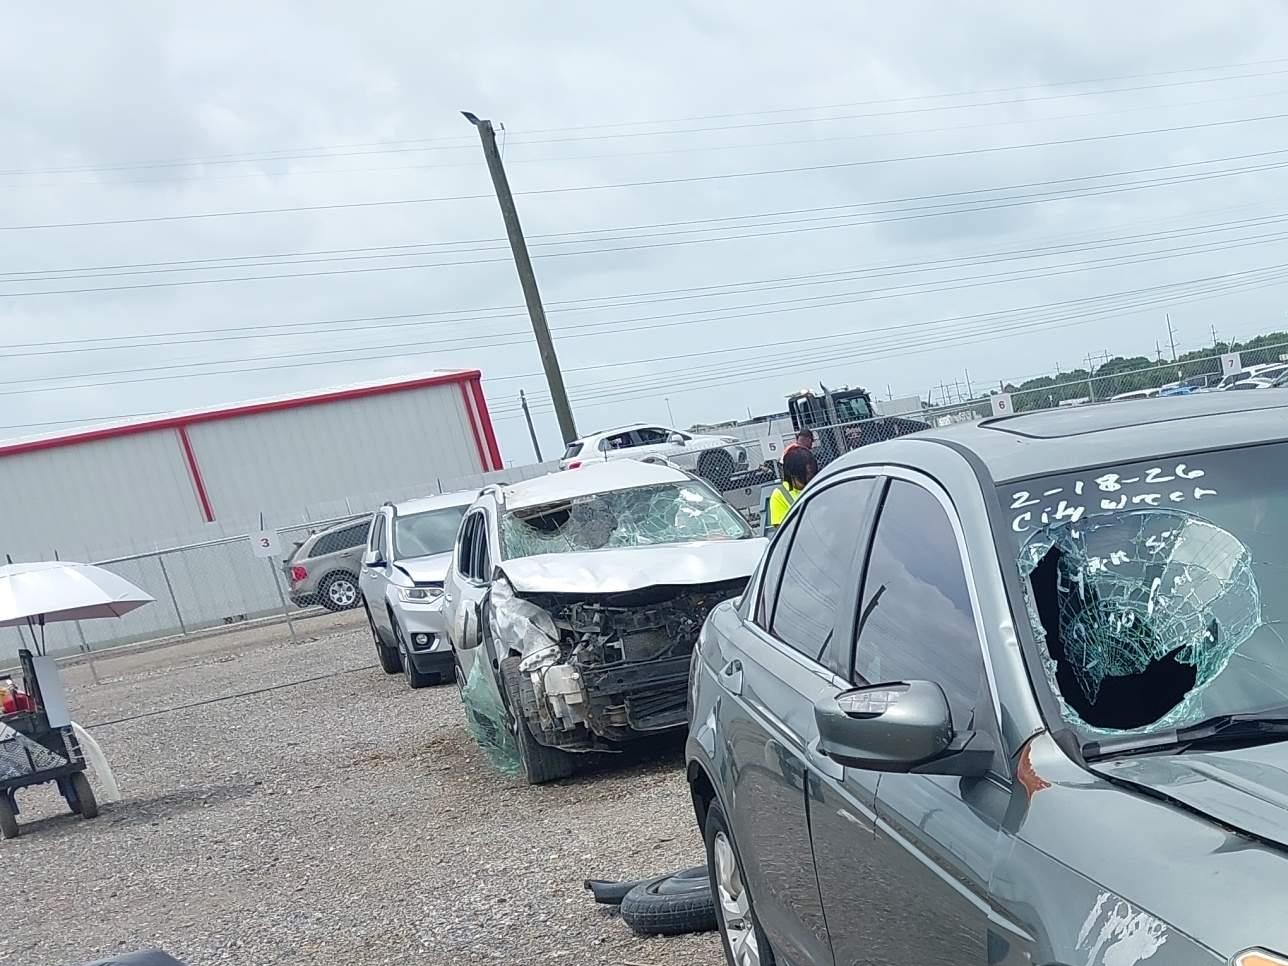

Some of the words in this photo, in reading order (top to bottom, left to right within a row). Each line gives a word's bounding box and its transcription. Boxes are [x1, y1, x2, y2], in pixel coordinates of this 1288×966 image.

[1227, 359, 1234, 368] 7
[998, 400, 1006, 410] 6
[768, 442, 777, 452] 5
[260, 538, 270, 548] 3
